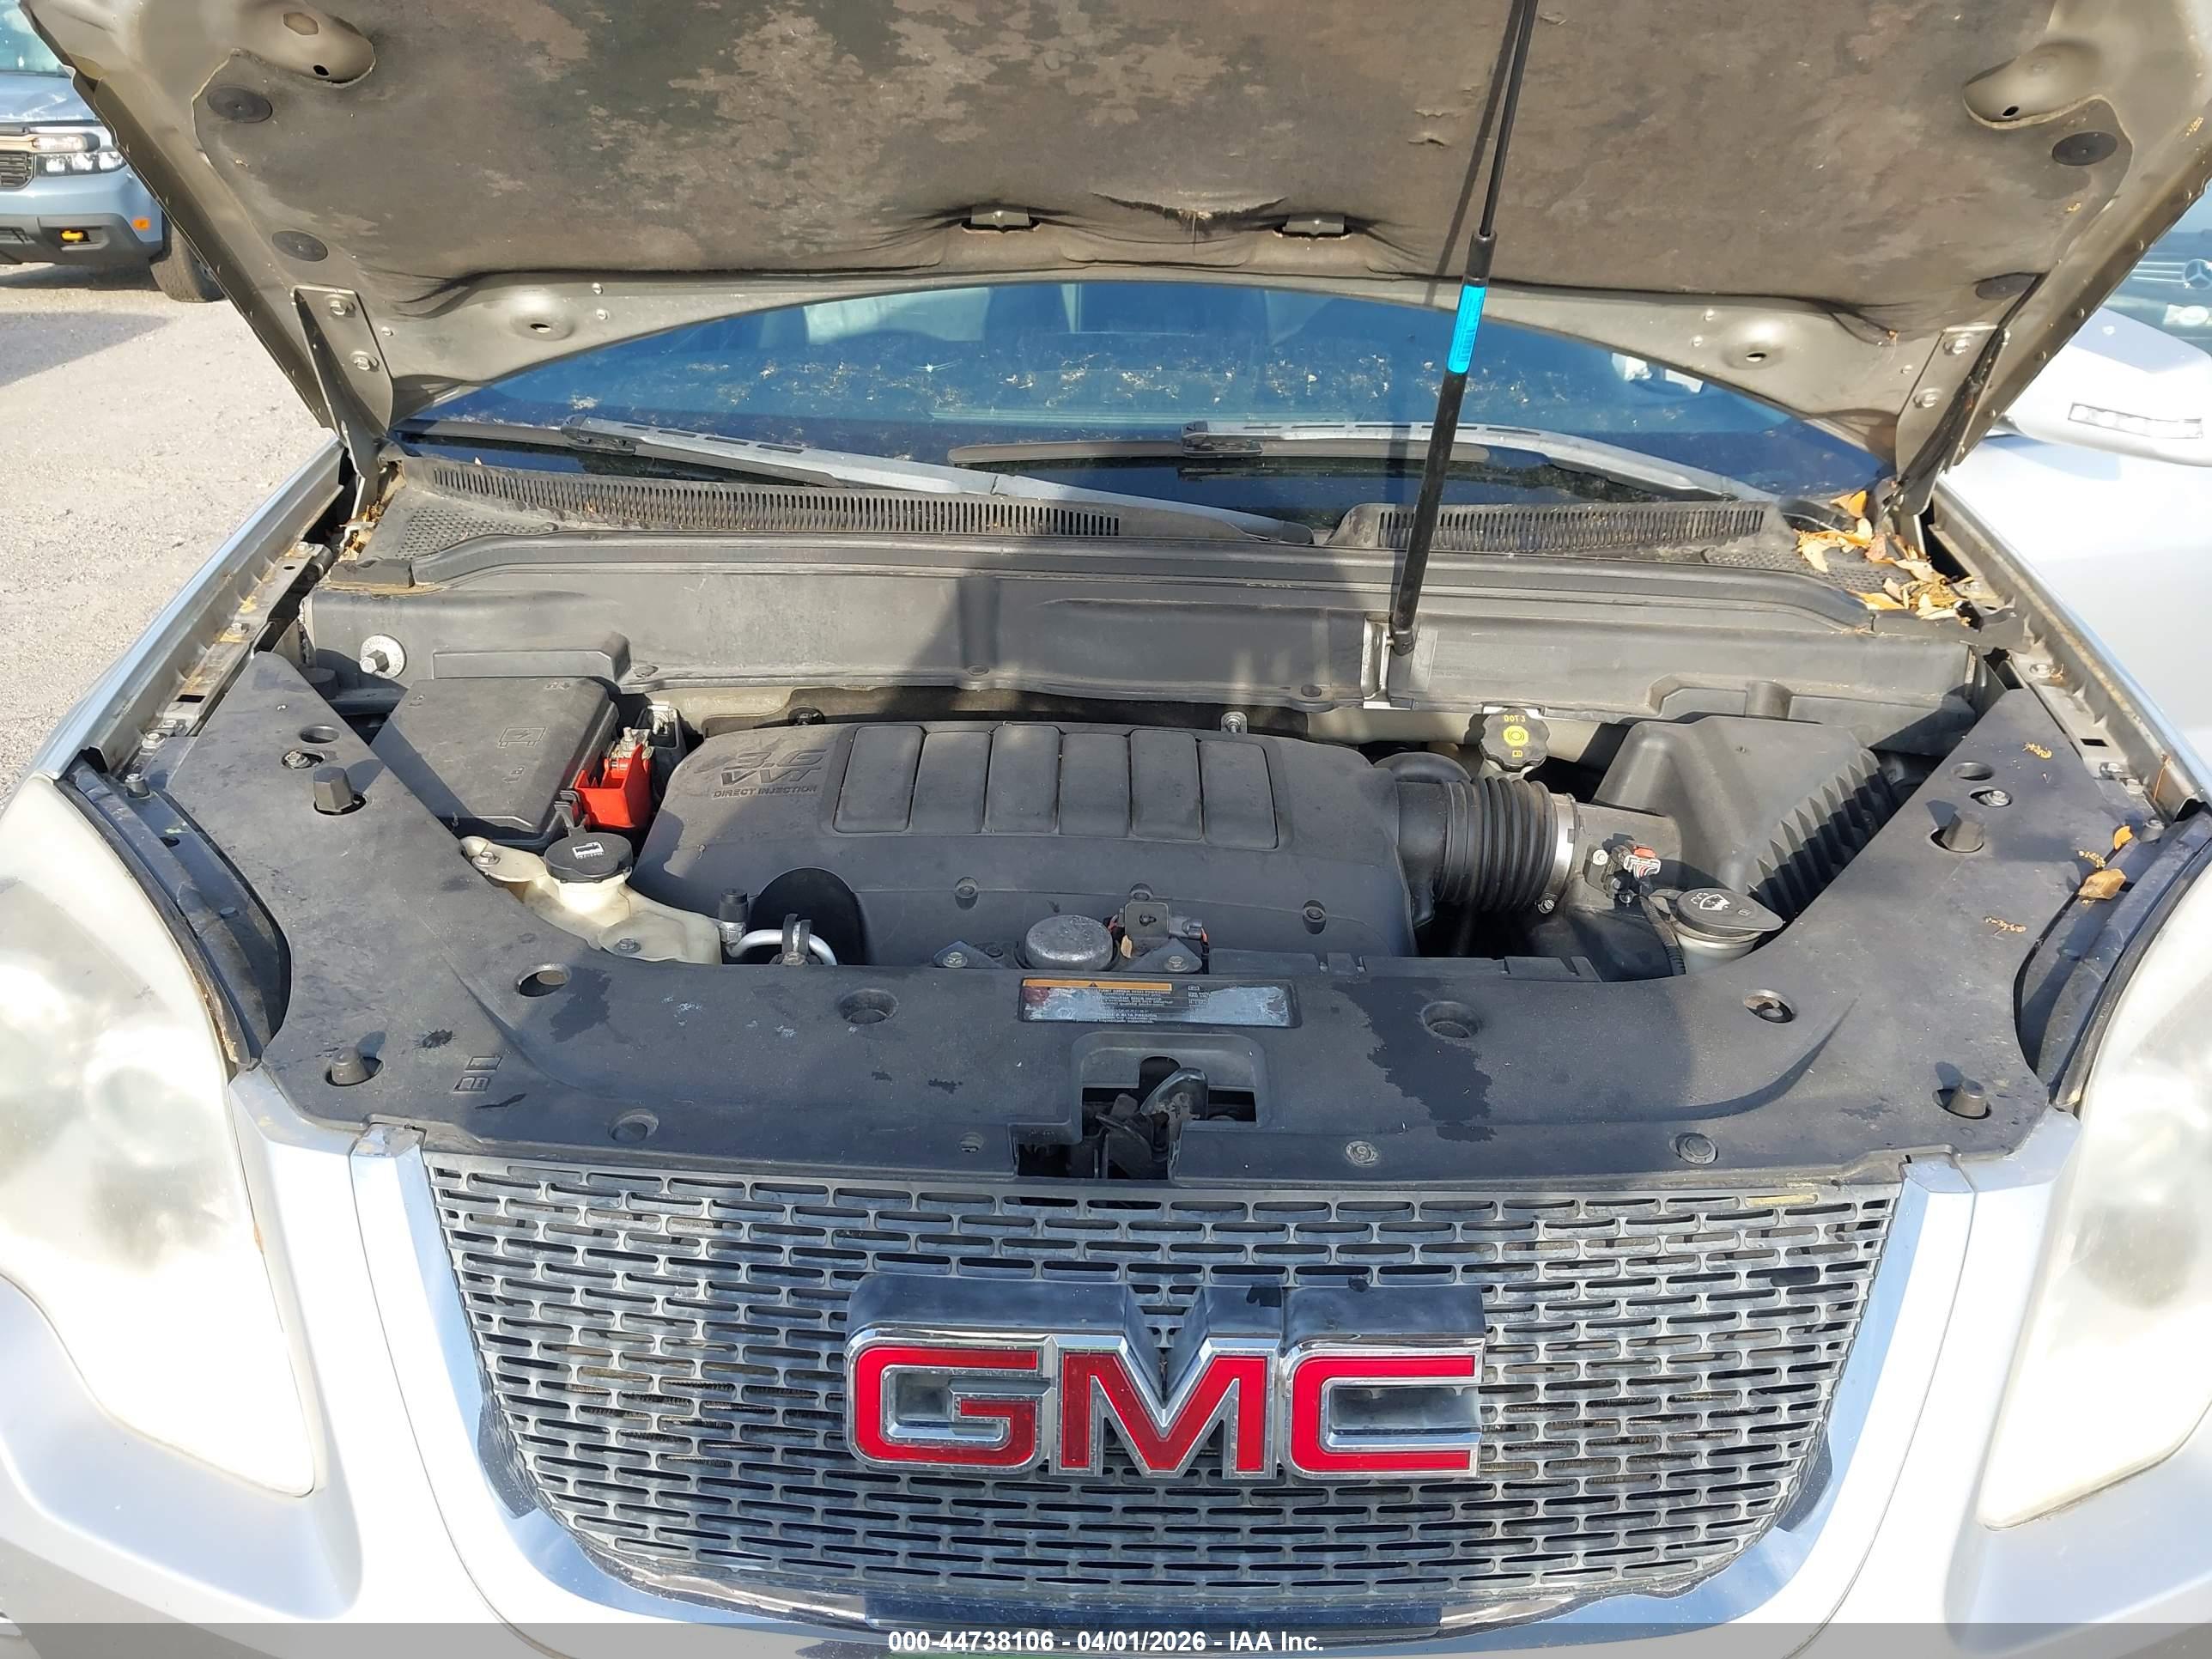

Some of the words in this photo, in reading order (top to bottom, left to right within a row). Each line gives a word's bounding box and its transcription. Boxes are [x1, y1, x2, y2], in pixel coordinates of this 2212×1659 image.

[724, 749, 827, 771] 3.6
[721, 768, 822, 786] VVT
[713, 787, 757, 799] DIRECT
[757, 786, 817, 796] INJECTION
[846, 1325, 1484, 1480] GMC
